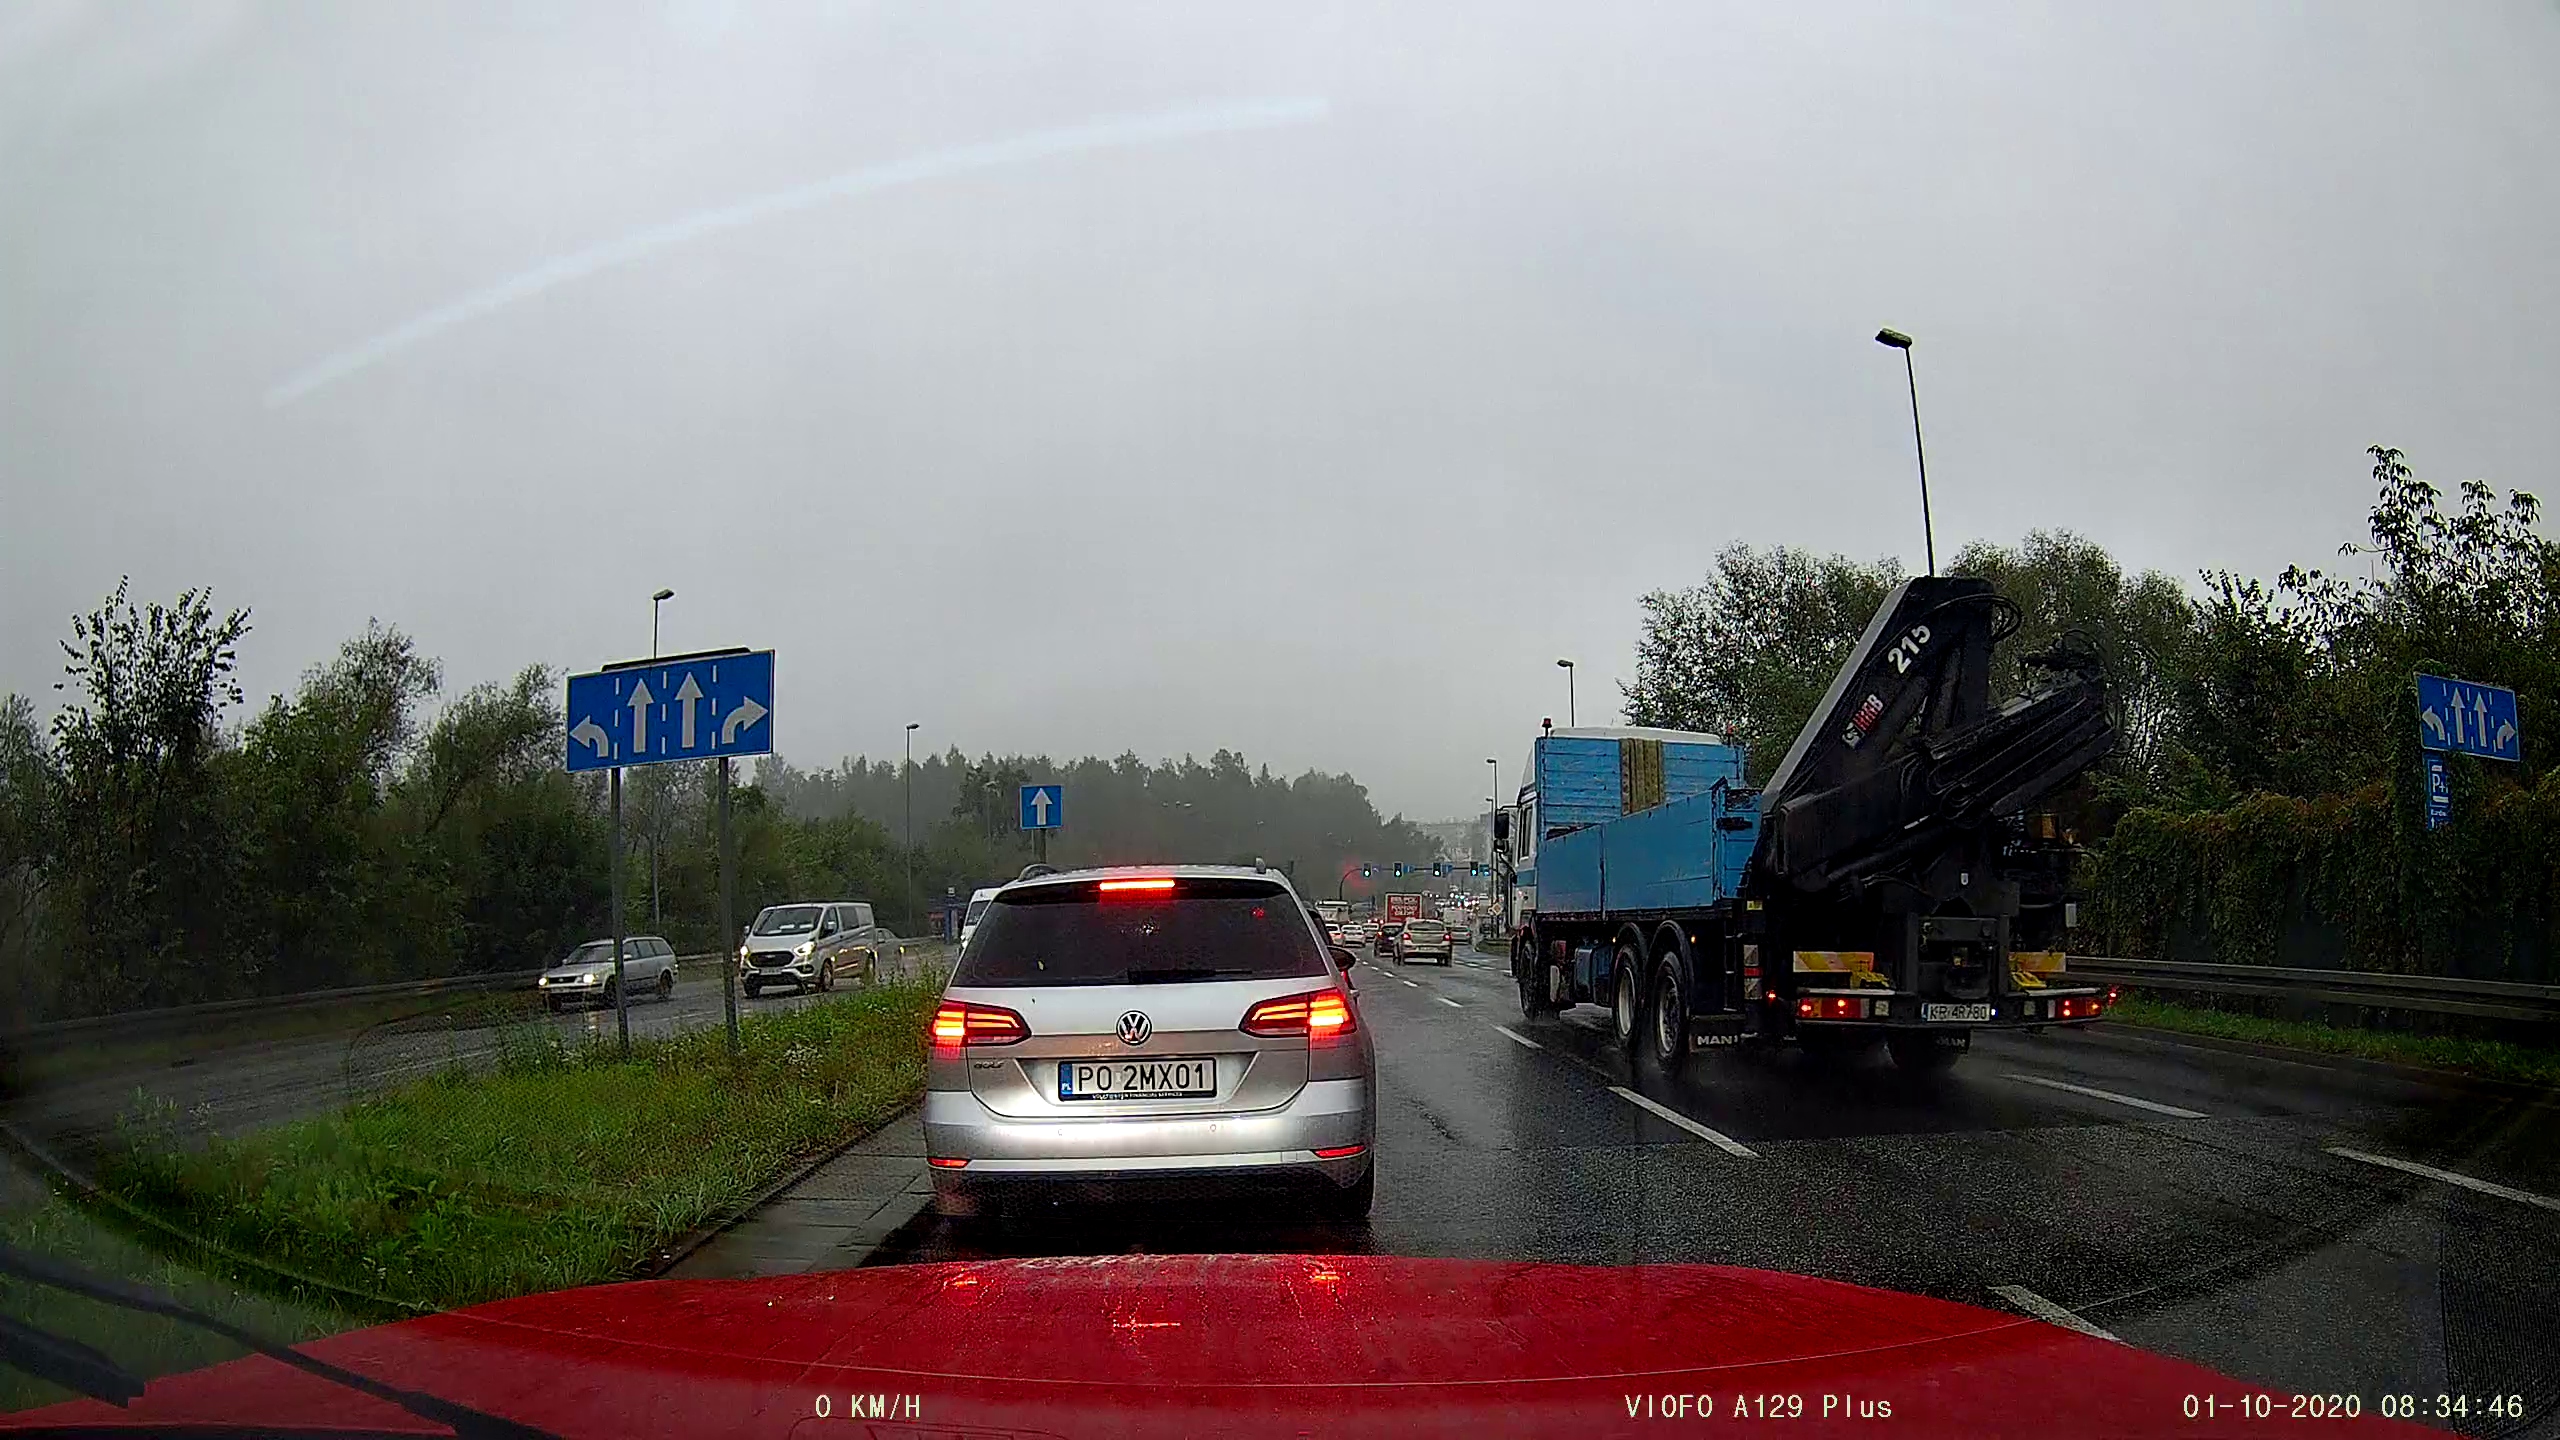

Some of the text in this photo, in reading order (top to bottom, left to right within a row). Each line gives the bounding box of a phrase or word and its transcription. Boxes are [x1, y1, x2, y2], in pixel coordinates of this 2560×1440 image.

[1887, 624, 1931, 674] 215
[1929, 1005, 1948, 1020] KR
[1697, 1034, 1733, 1046] MAN
[1078, 1062, 1205, 1092] PO 2MX01
